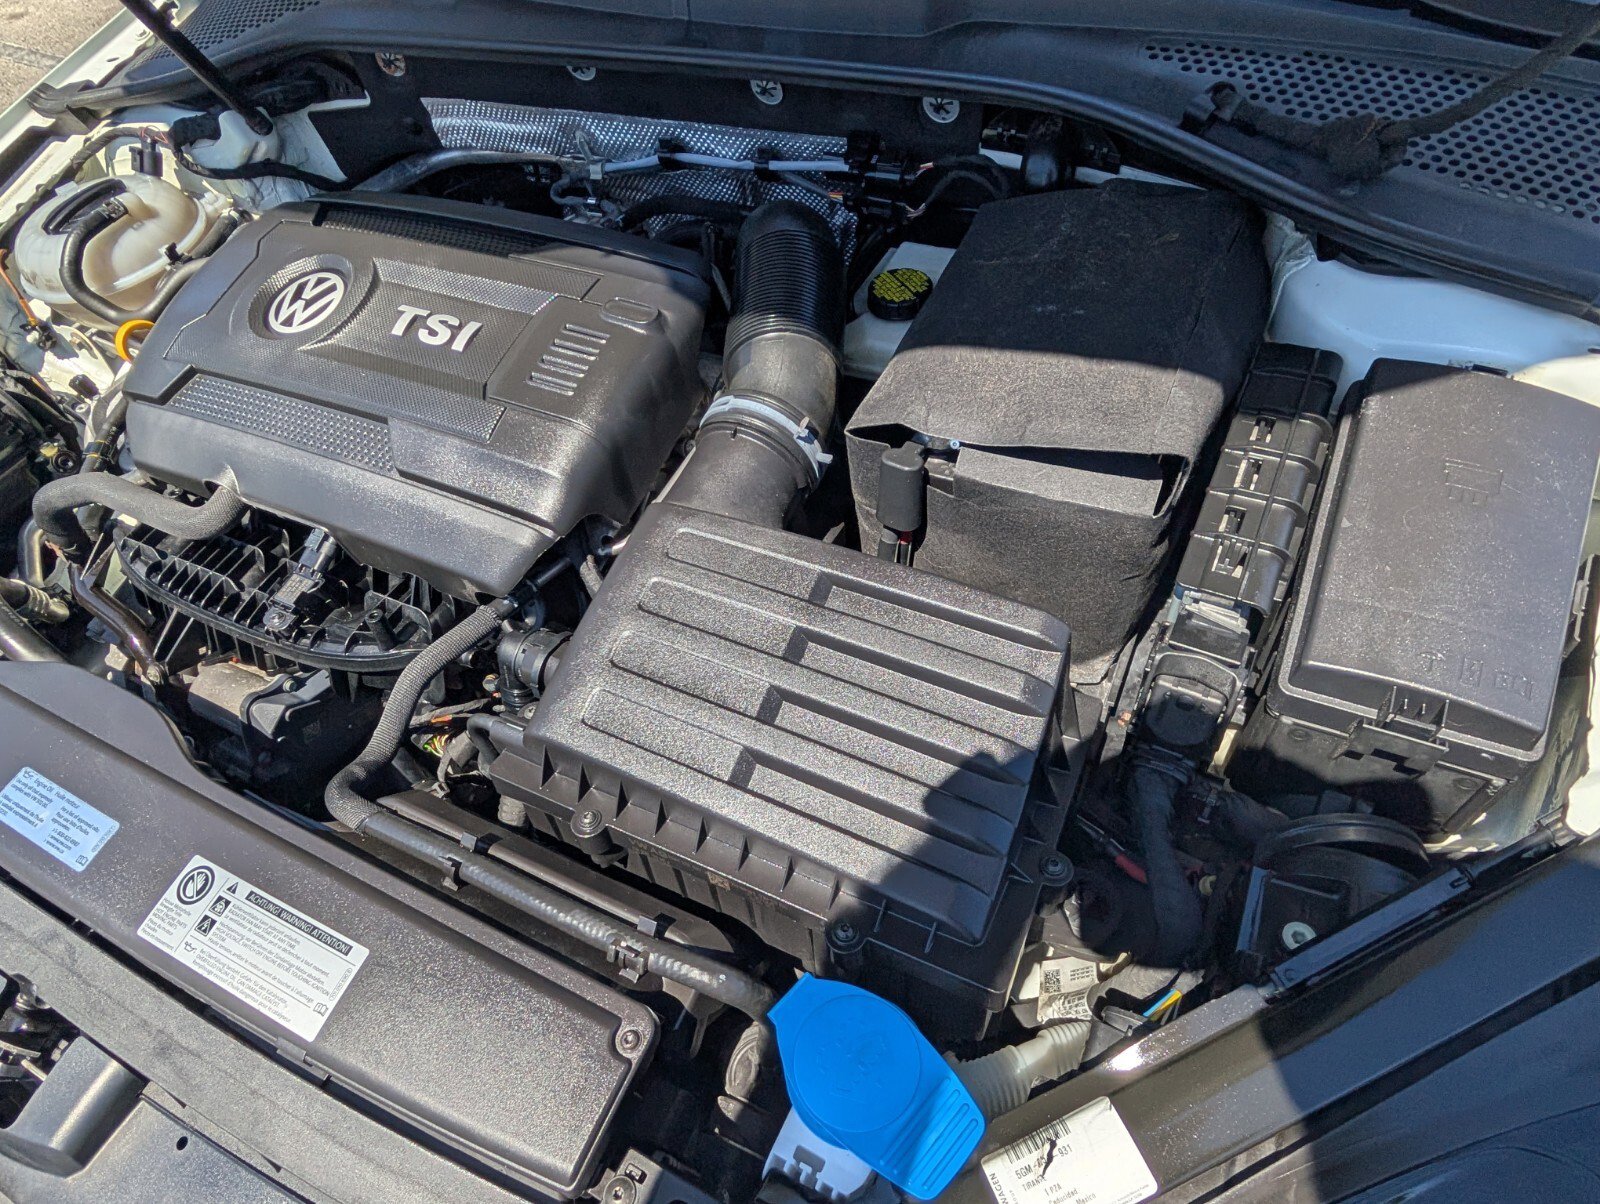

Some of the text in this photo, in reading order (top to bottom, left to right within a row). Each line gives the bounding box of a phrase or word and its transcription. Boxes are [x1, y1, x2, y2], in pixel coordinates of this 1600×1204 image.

[391, 304, 483, 352] TSI
[248, 893, 349, 954] ACHTUNG! WARNING! ATTENTION!
